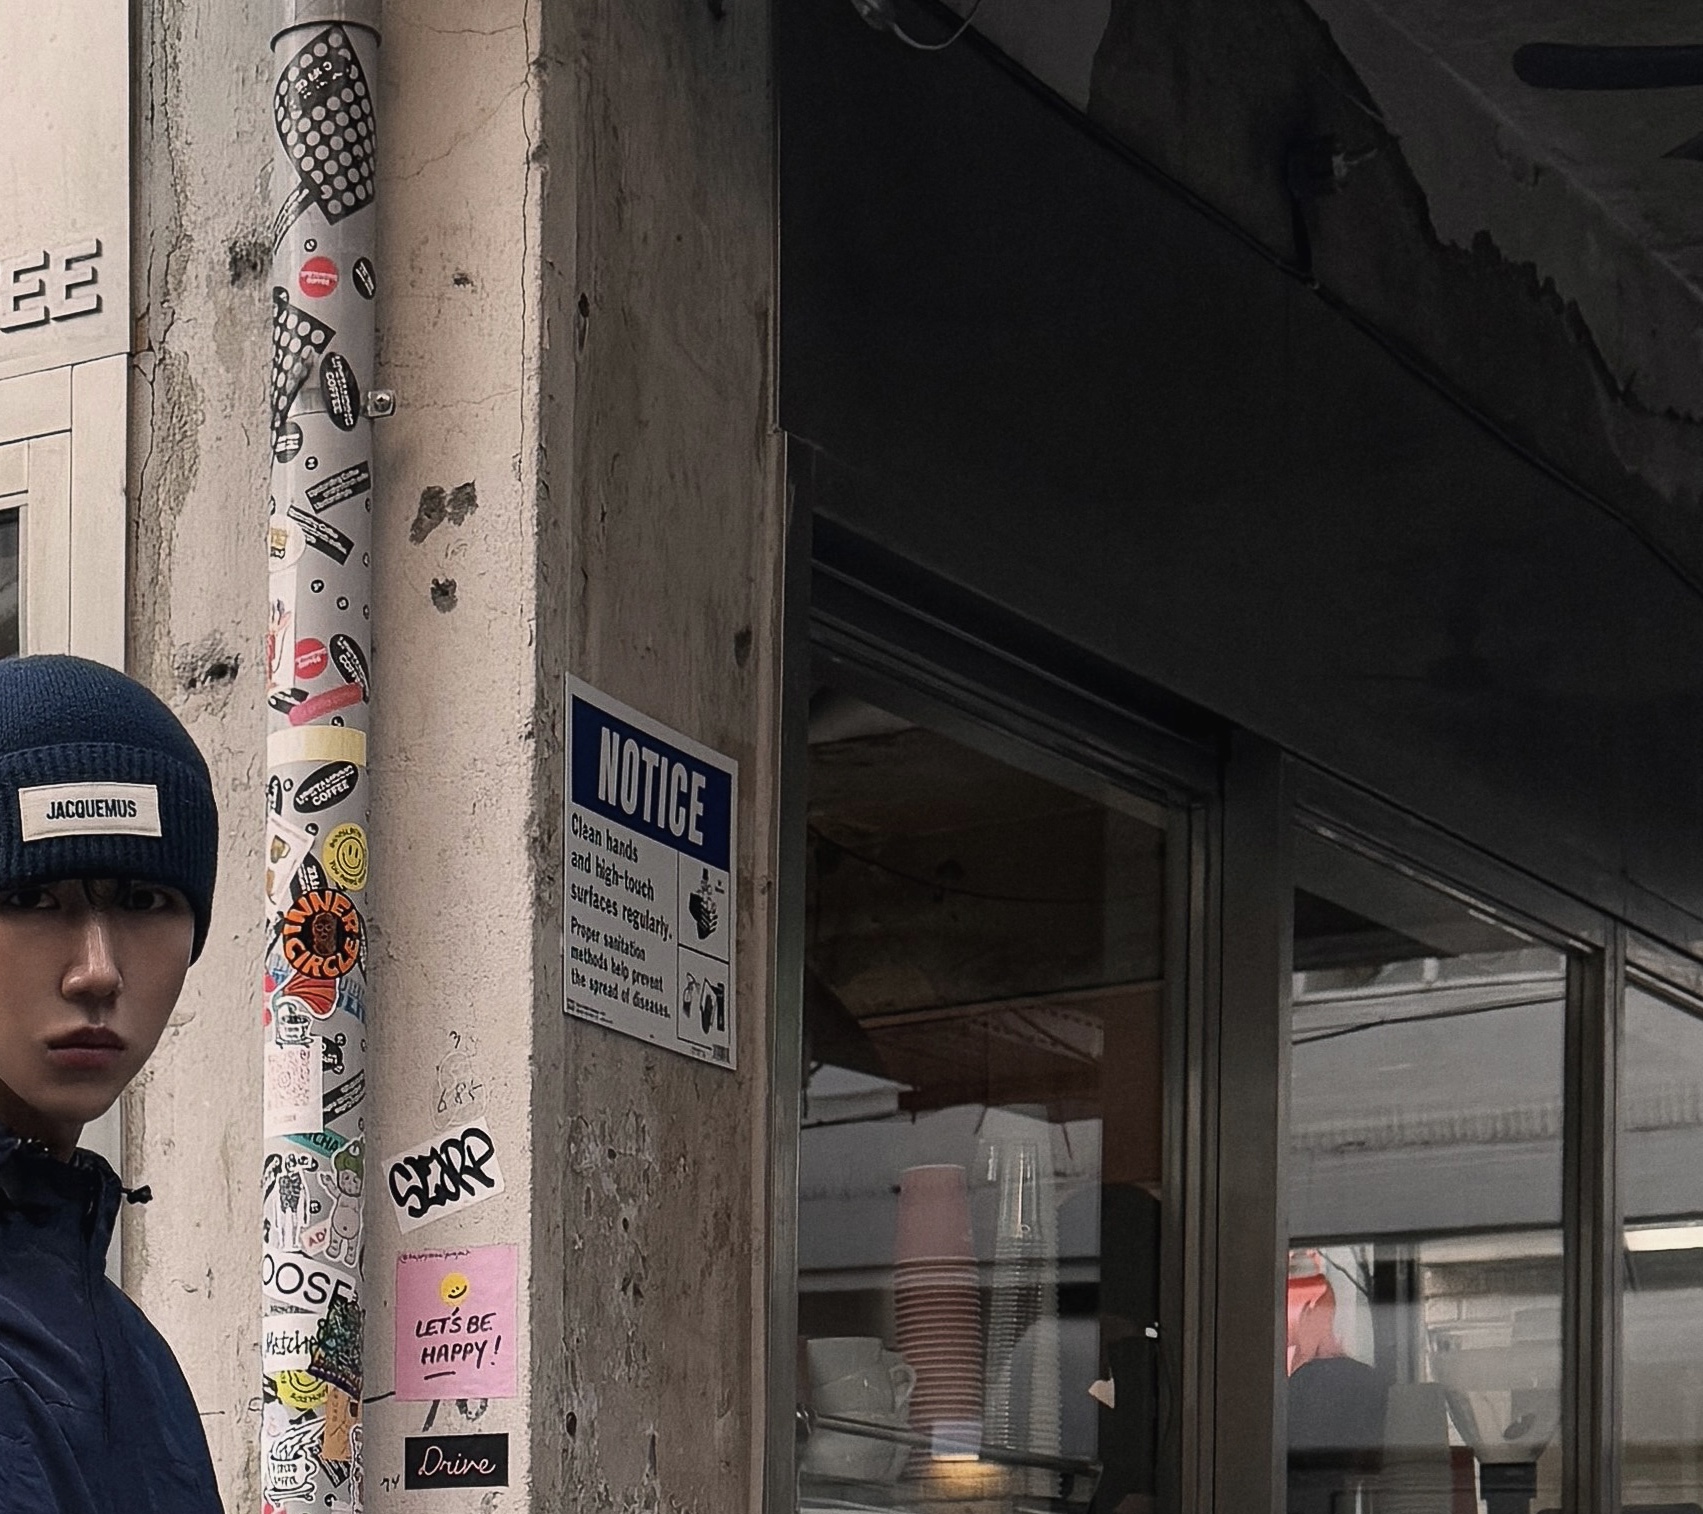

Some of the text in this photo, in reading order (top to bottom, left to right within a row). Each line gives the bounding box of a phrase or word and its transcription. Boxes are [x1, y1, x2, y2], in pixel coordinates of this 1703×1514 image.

[312, 779, 350, 806] COFFEE
[598, 726, 707, 846] NOTICE
[46, 799, 137, 819] JACQUEMUS
[571, 812, 638, 863] Clean hands
[571, 851, 654, 901] and high-touch
[283, 890, 359, 935] INNER
[571, 883, 672, 942] surfaces regularly.
[571, 916, 600, 943] Proper
[285, 937, 359, 977] CIRCLE
[611, 956, 629, 981] help
[571, 967, 586, 987] the
[589, 978, 618, 1000] spread
[621, 987, 630, 1004] of
[415, 1307, 497, 1339] LET'S BE
[418, 1446, 496, 1476] Drive
